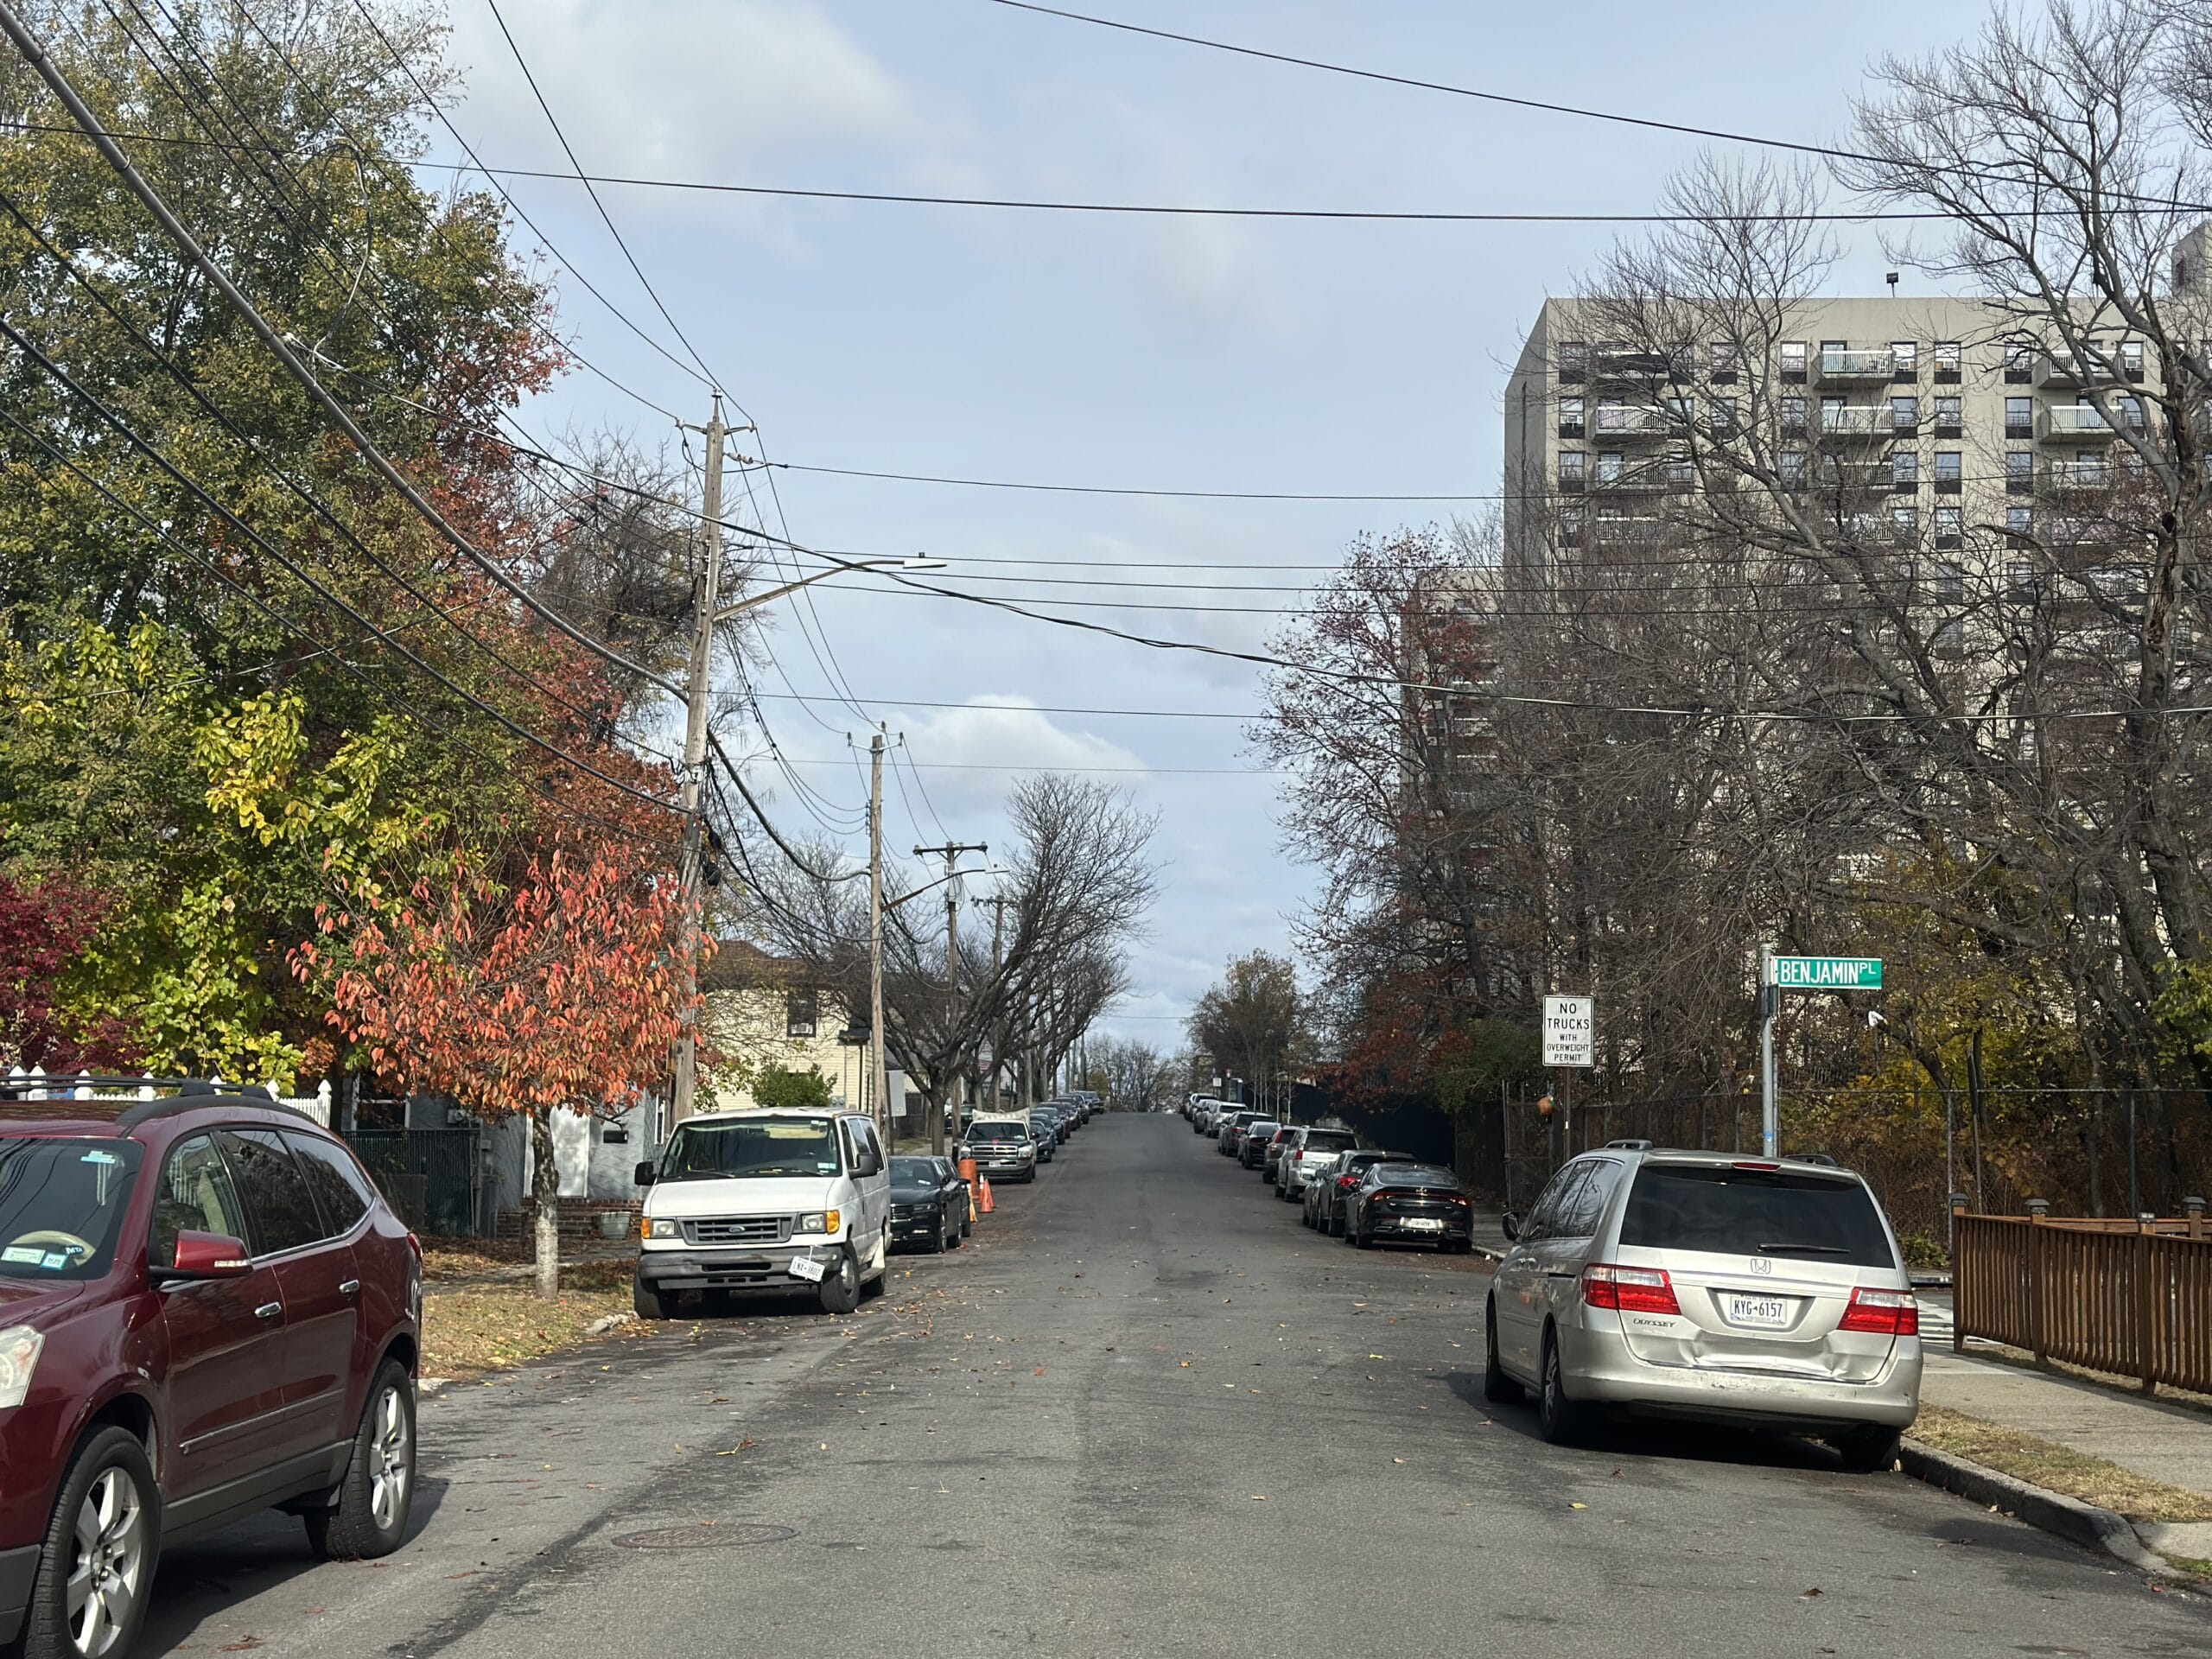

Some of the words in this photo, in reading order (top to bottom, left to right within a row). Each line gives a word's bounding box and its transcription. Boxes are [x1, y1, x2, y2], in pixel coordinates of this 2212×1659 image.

[1781, 960, 1859, 984] BENJAMIN
[1859, 963, 1876, 975] PL
[1560, 1002, 1577, 1014] NO
[1547, 1018, 1590, 1029] TRUCKS
[1547, 1043, 1589, 1052] OVERWEIGHT
[1554, 1053, 1581, 1062] PERMIT
[1633, 1318, 1676, 1327] ODYSSEY
